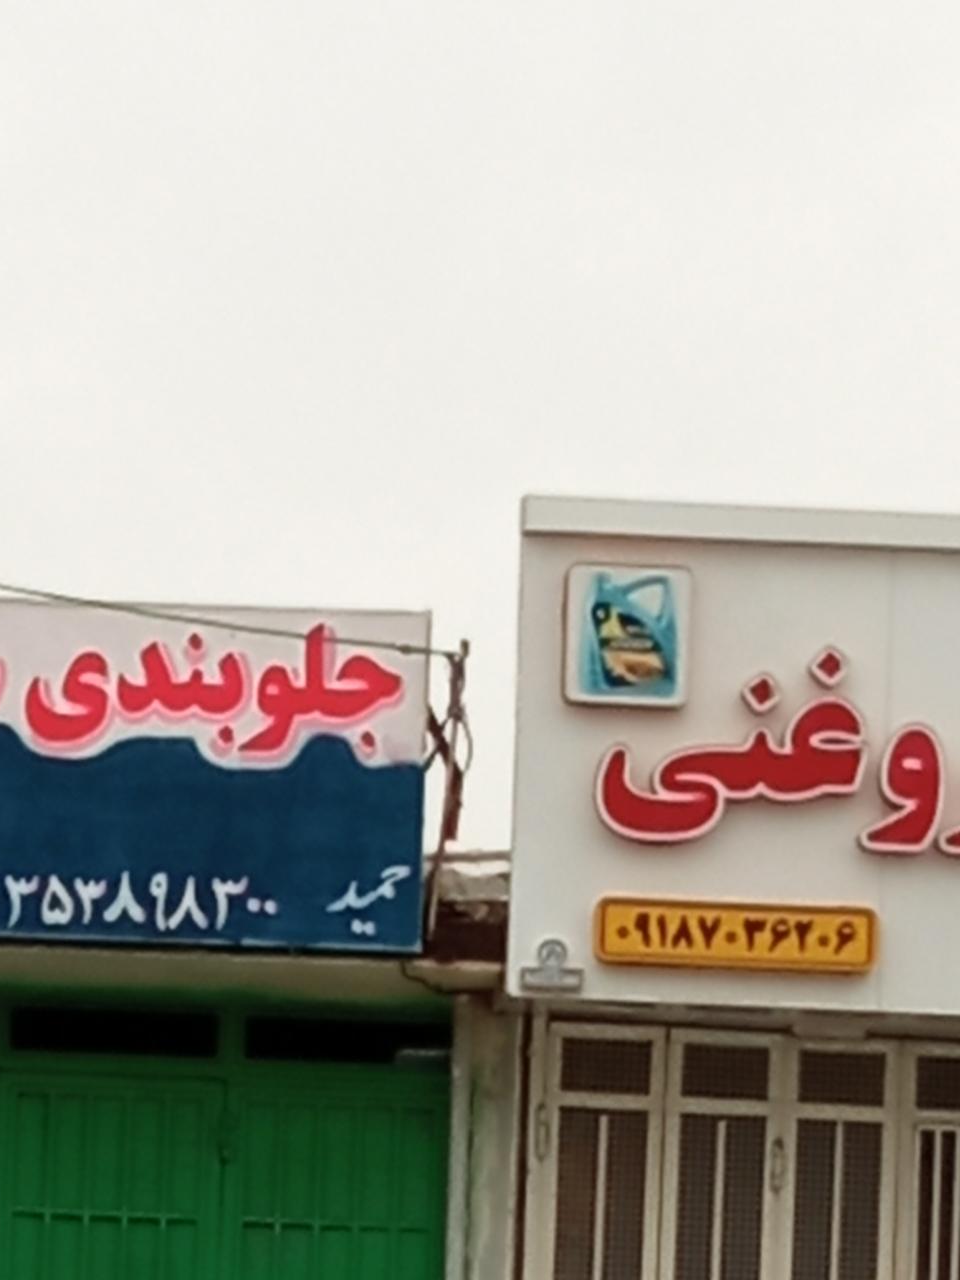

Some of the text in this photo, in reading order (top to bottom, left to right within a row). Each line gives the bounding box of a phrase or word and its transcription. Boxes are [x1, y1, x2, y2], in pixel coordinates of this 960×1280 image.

[24, 622, 403, 752] جلوبندی
[597, 645, 960, 853] وغنی
[326, 865, 411, 936] حمید
